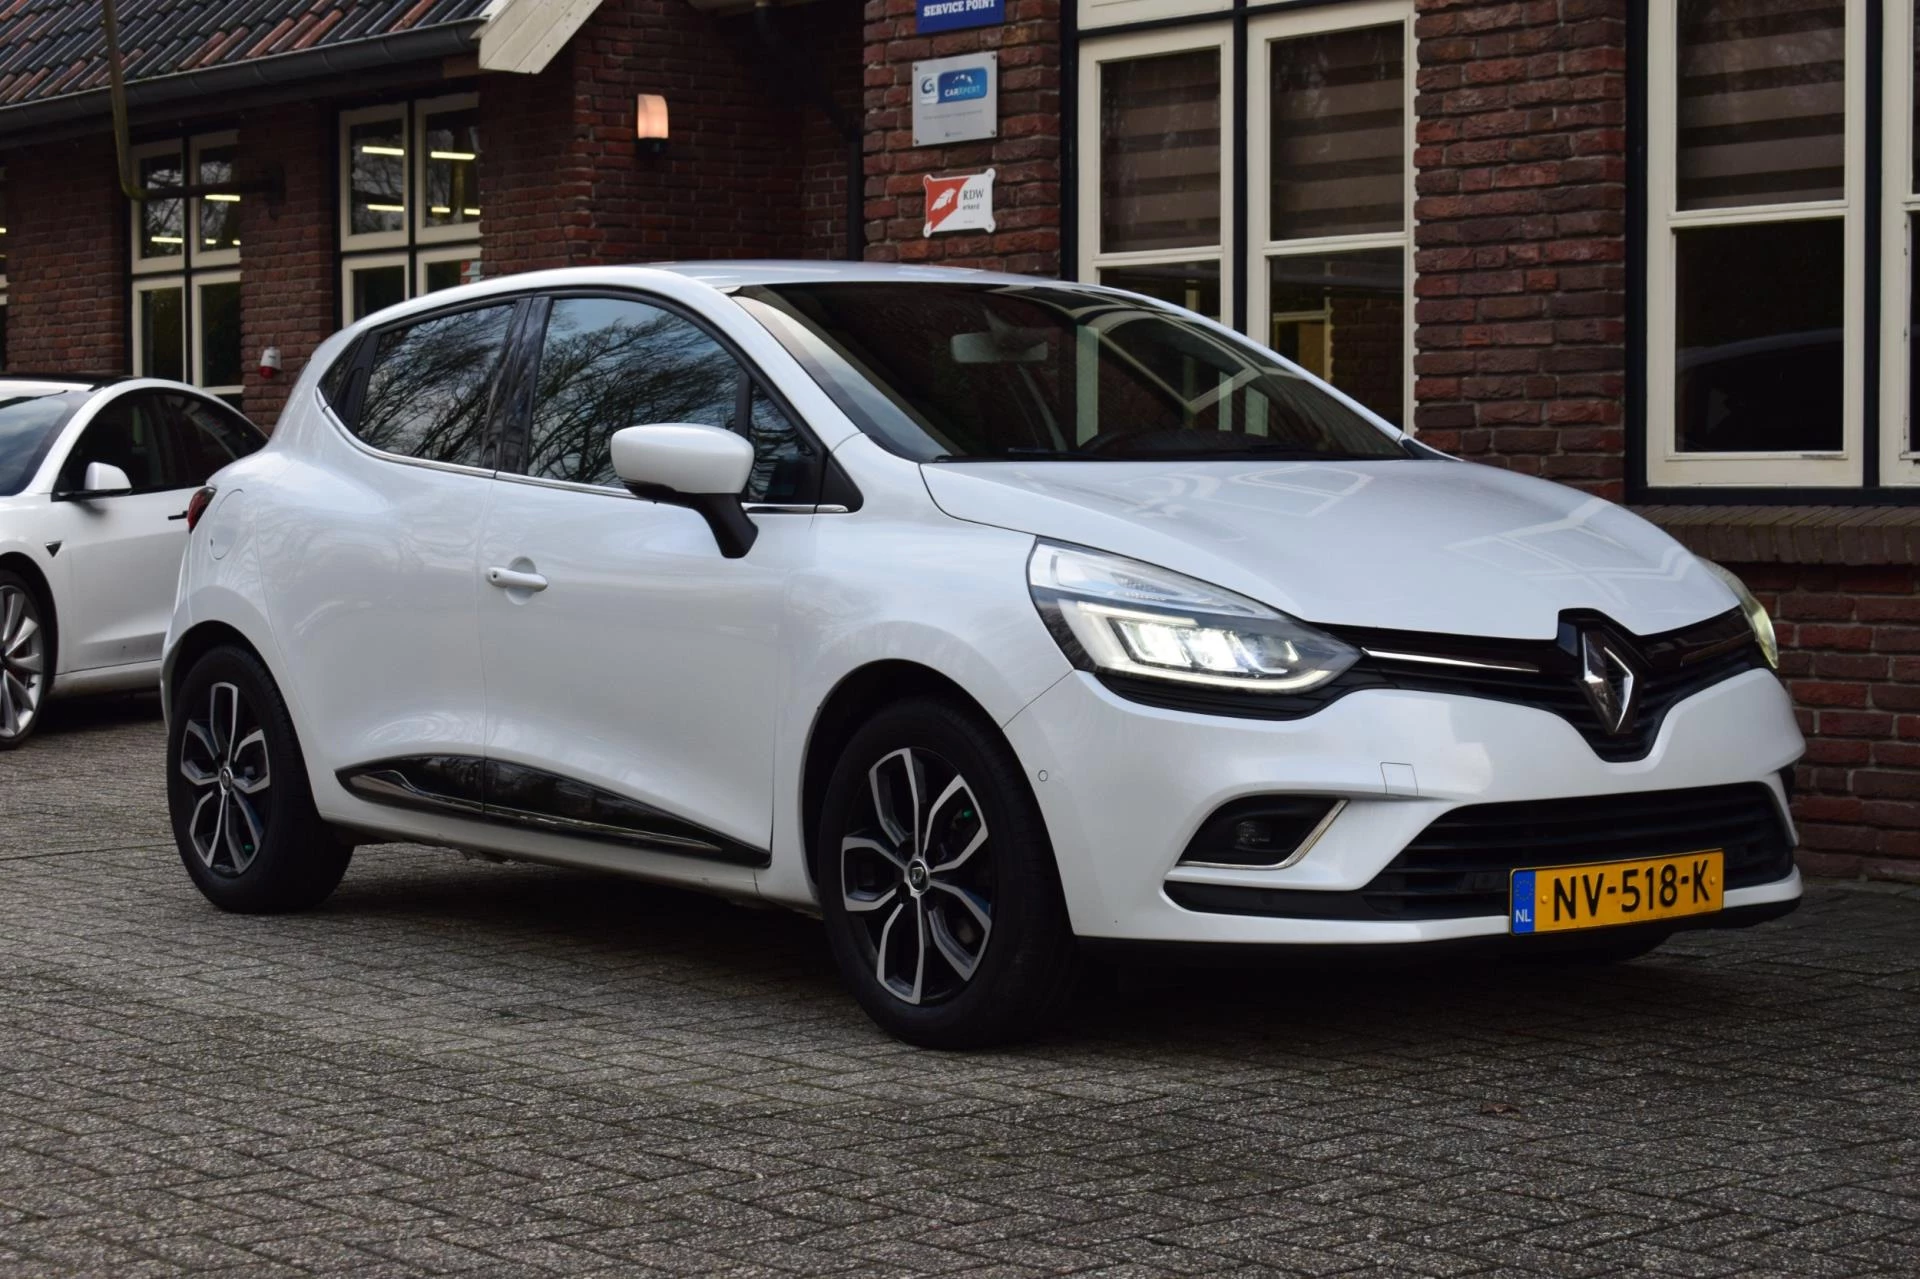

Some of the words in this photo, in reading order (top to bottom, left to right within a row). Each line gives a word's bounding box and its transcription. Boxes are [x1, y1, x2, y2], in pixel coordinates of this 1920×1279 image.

[924, 1, 964, 17] SERVICE
[966, 0, 995, 11] POINT
[963, 188, 984, 200] RDW
[1515, 909, 1532, 923] NL
[1553, 860, 1709, 921] NV-518-K
